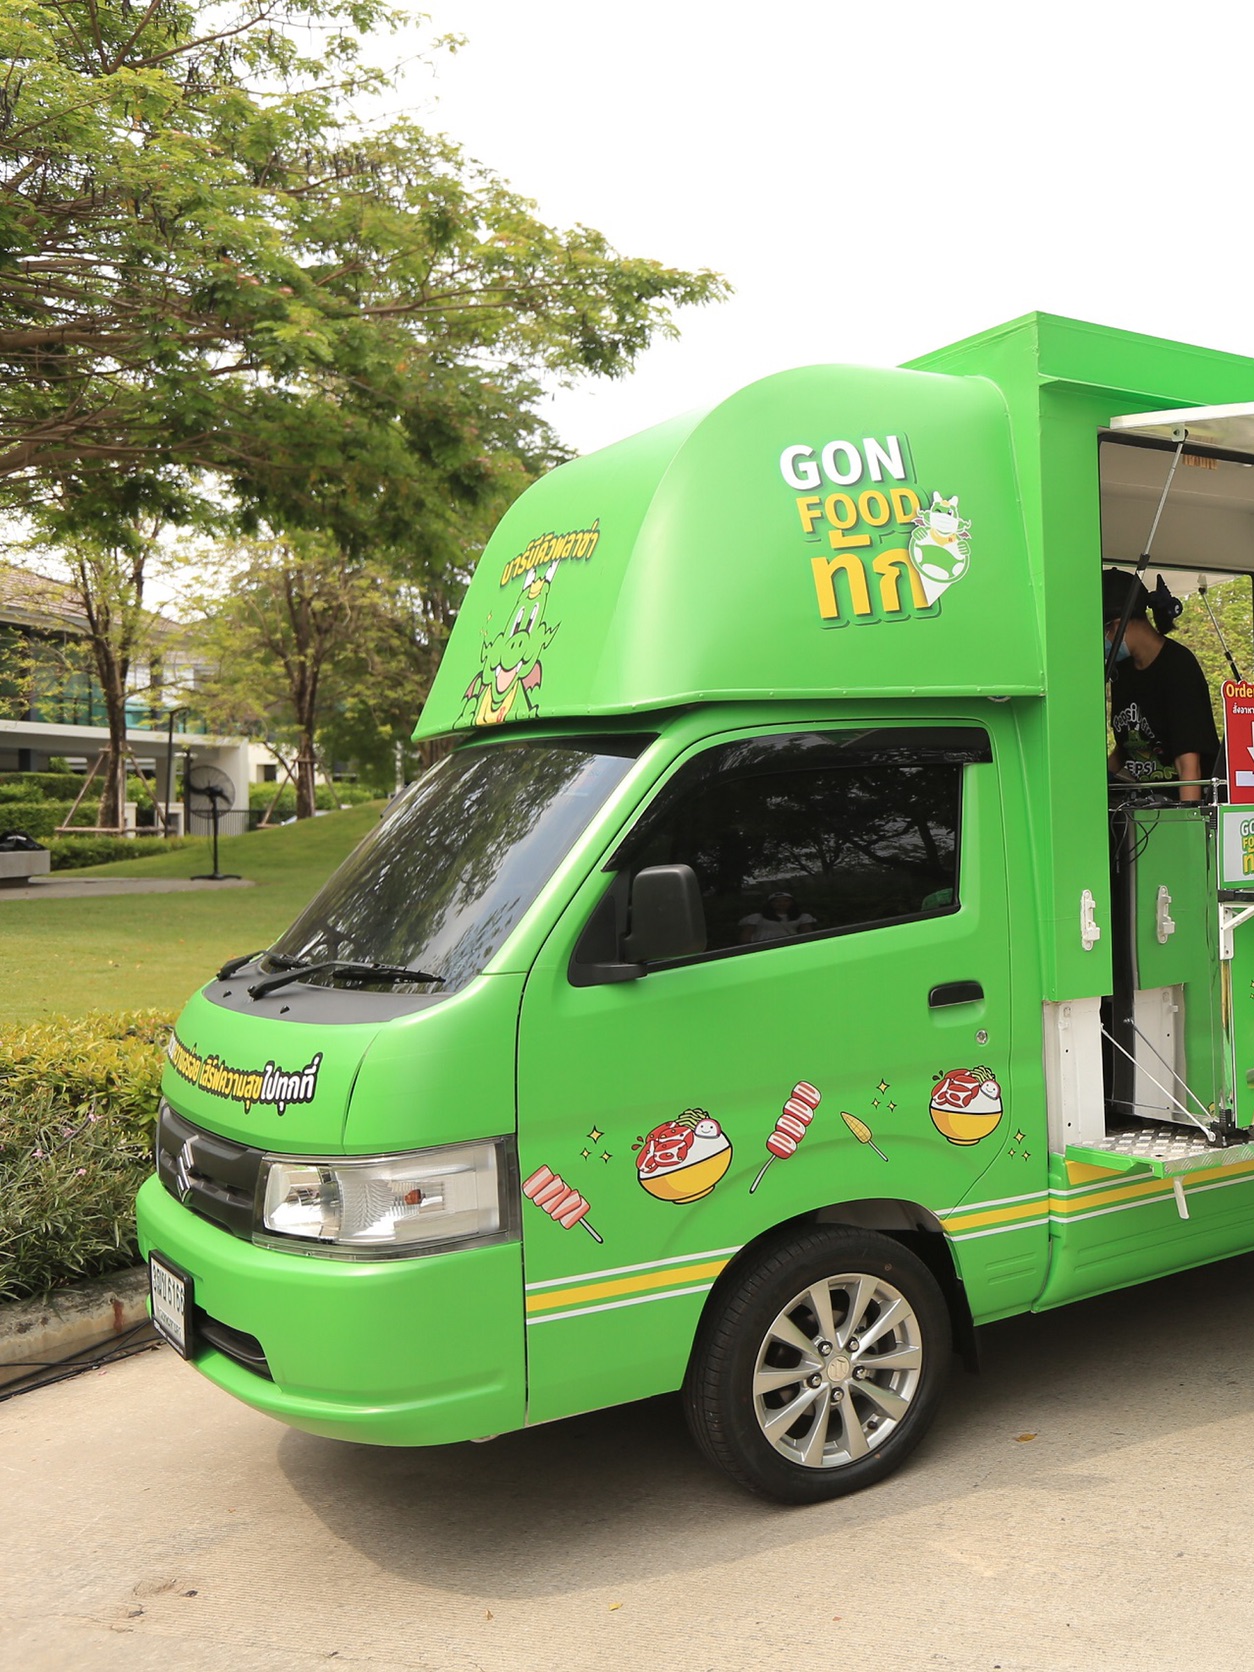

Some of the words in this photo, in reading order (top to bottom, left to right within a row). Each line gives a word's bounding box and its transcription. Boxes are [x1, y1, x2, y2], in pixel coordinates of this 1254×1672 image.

[779, 435, 905, 491] GON
[796, 487, 921, 532] FOOD
[500, 518, 600, 587] บาร์บีคิวพลาซ่า
[200, 1056, 321, 1112] เสิร์ฟความสุขไปทุกที่
